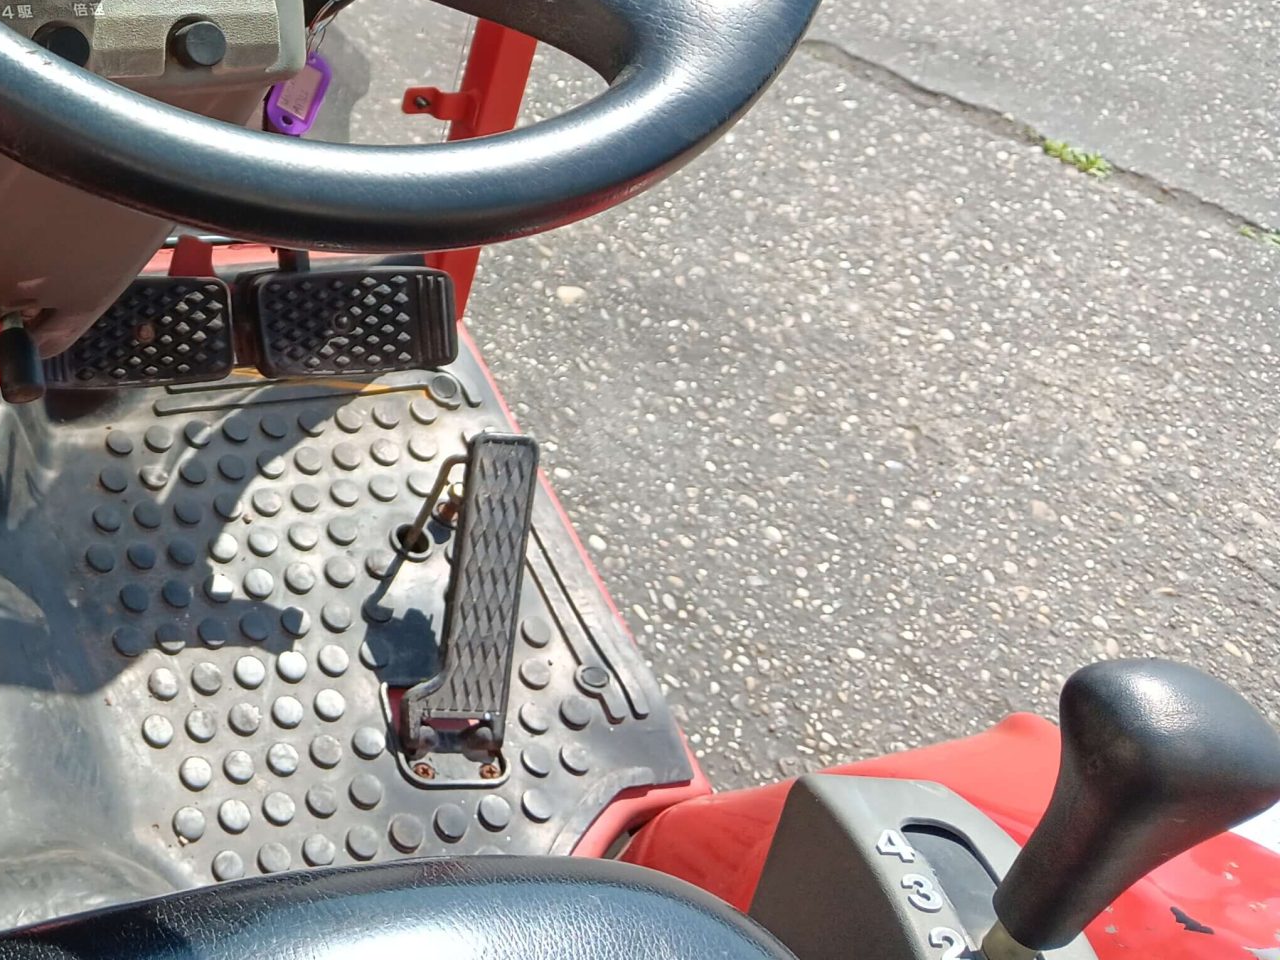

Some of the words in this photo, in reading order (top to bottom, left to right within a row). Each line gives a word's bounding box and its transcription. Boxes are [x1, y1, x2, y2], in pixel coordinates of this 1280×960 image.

[73, 2, 105, 17] 倍速
[876, 829, 915, 863] 4
[901, 873, 943, 913] 3
[928, 926, 969, 960] 2
